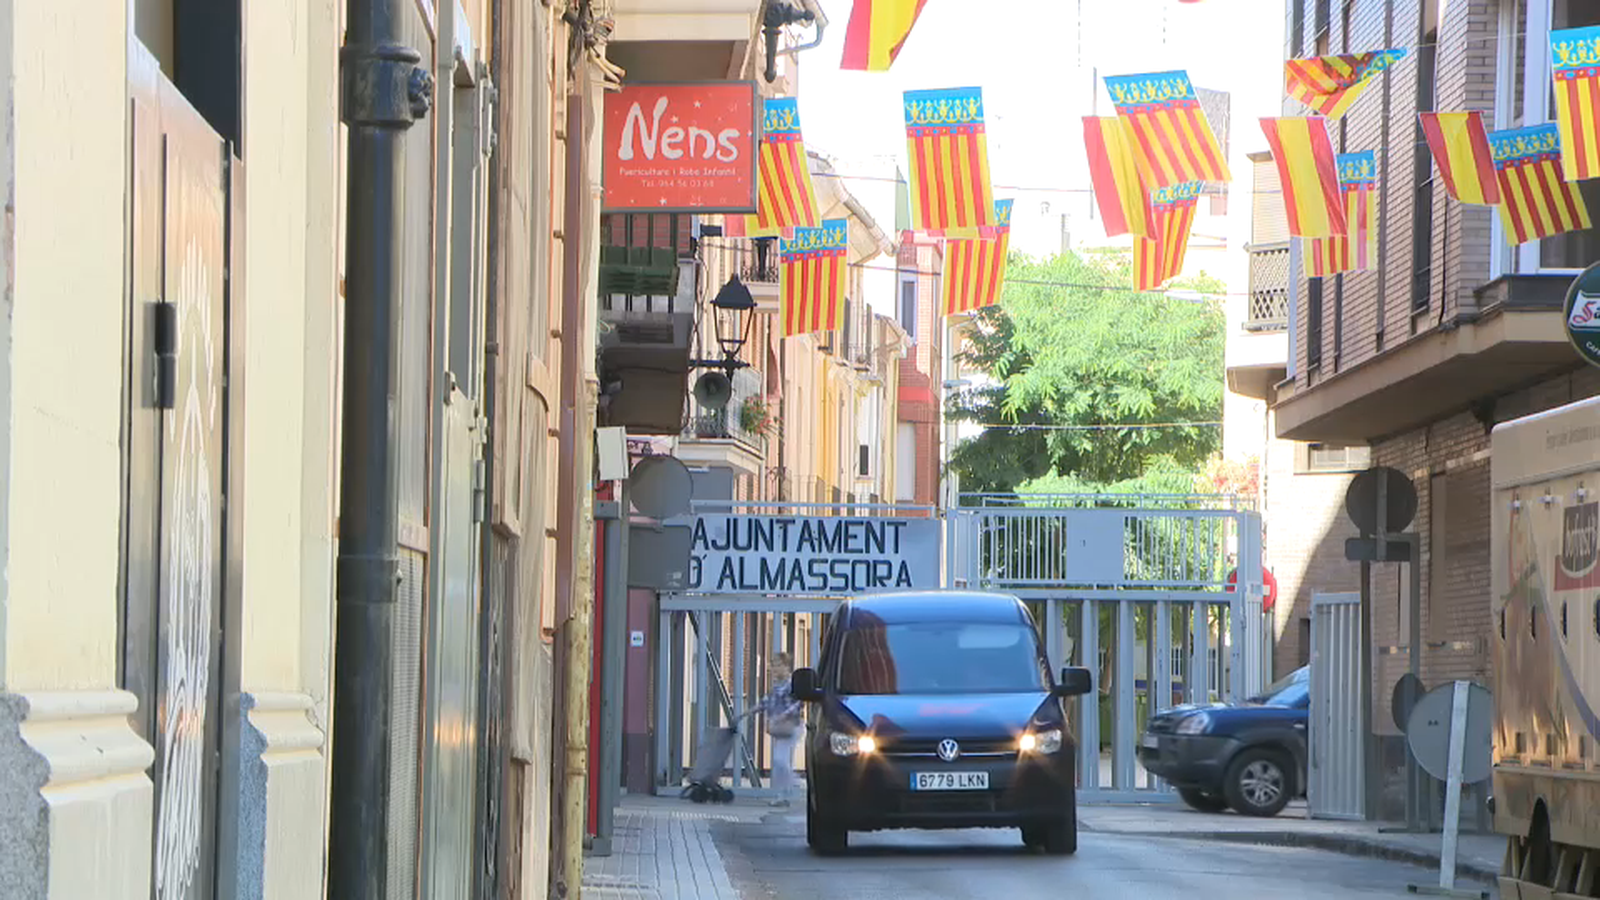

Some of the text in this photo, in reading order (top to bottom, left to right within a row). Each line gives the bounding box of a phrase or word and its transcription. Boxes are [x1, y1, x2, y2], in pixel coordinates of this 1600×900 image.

[618, 96, 740, 163] Nens
[691, 517, 907, 554] AJUNTAMENT
[716, 556, 912, 592] ALMASSORA
[919, 774, 985, 788] 6779 LKN
